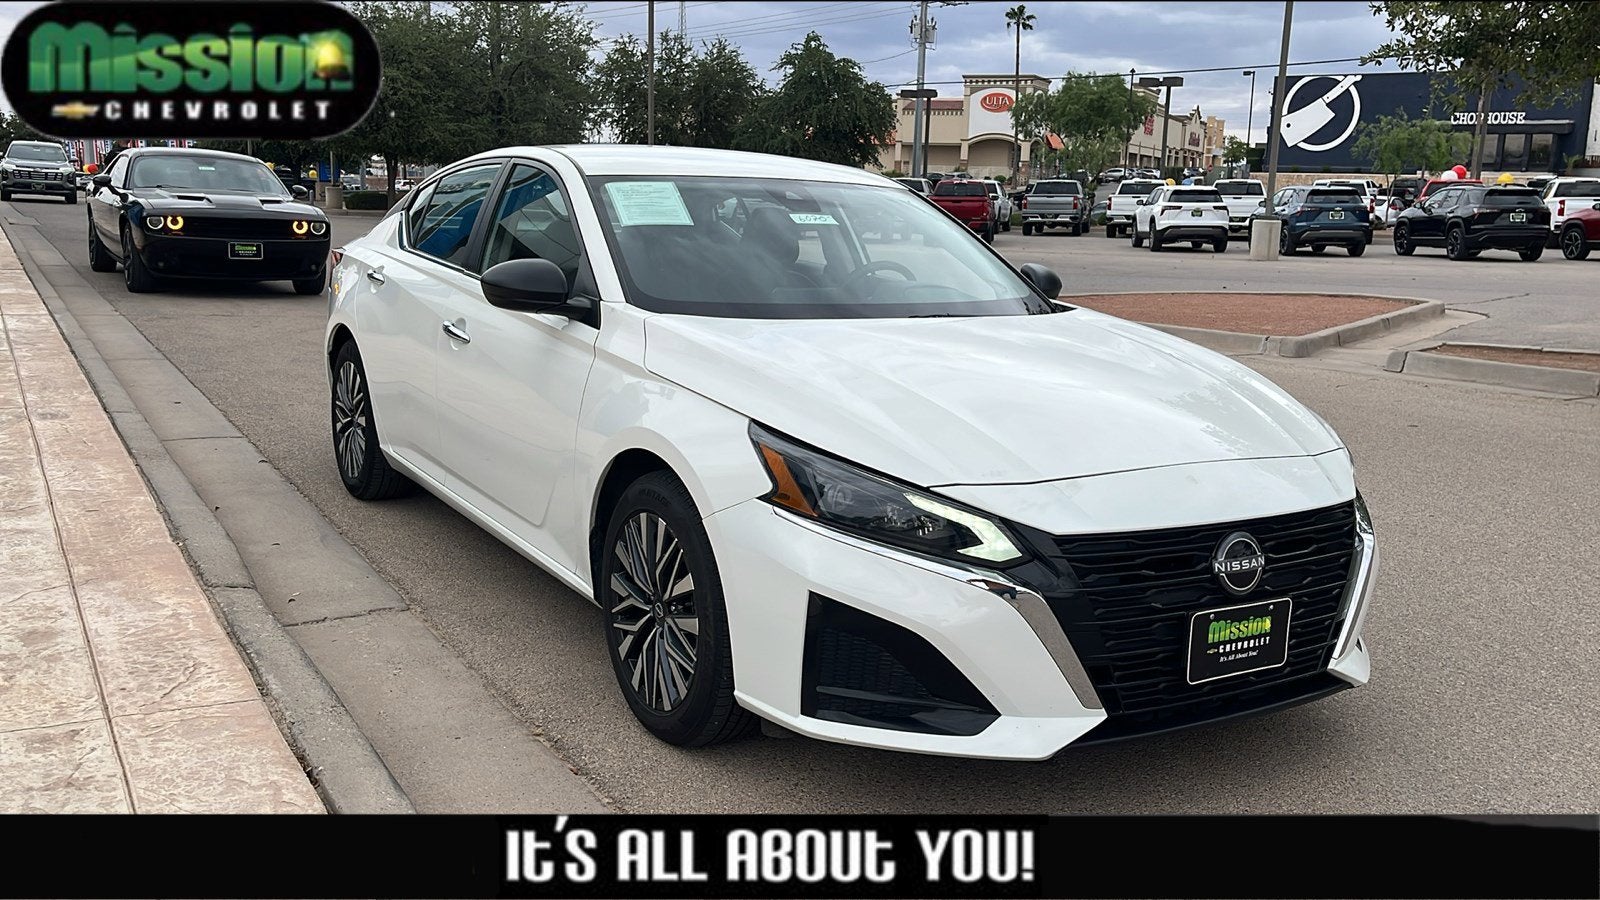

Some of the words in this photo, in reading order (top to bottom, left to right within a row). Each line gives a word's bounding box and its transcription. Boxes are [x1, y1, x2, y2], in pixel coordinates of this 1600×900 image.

[986, 96, 1010, 105] ULTA
[1214, 555, 1265, 572] NISSAN
[1208, 616, 1271, 644] Mission
[1219, 636, 1270, 653] CHEVROLET
